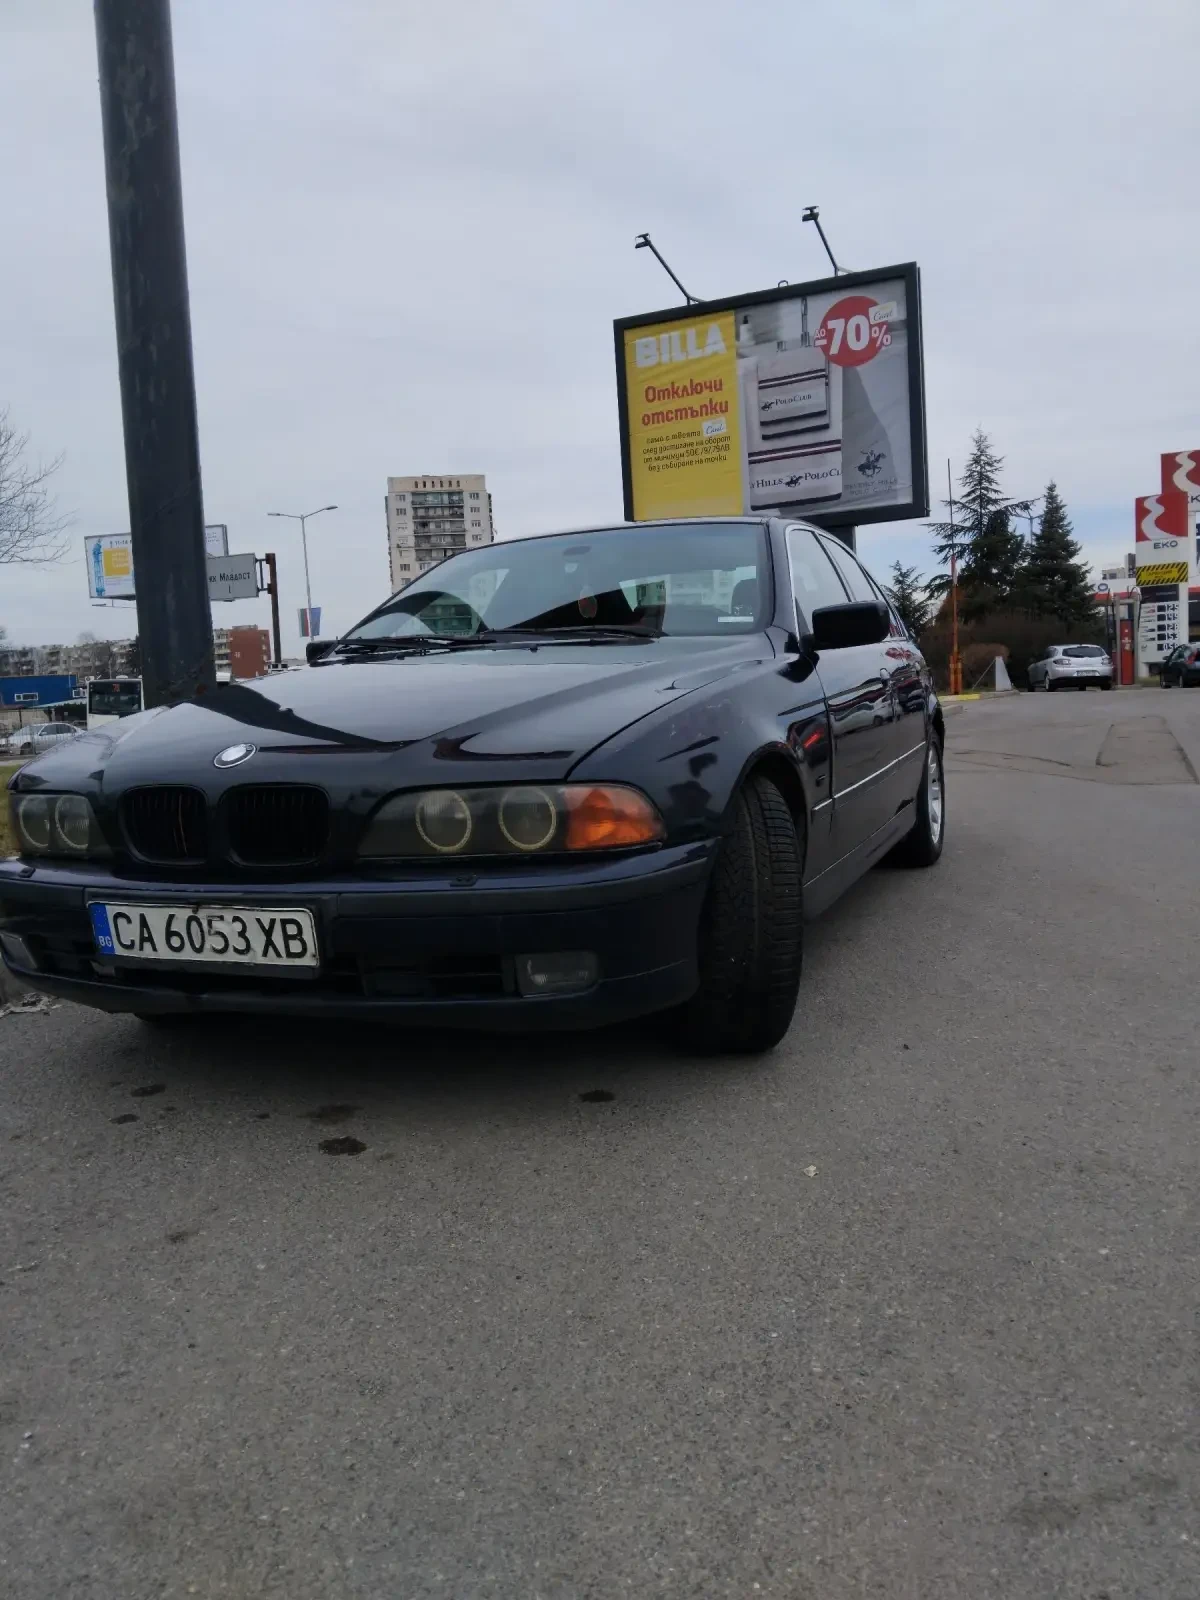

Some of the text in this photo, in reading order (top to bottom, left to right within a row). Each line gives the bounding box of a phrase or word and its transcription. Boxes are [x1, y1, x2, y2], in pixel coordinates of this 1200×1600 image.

[635, 323, 728, 368] BILLA
[644, 378, 723, 403] Отключи
[641, 397, 729, 426] отстъпки
[1153, 540, 1178, 549] EKO
[219, 572, 251, 582] Младост
[99, 935, 113, 948] BG
[112, 911, 158, 952] CA
[164, 913, 252, 956] 6053
